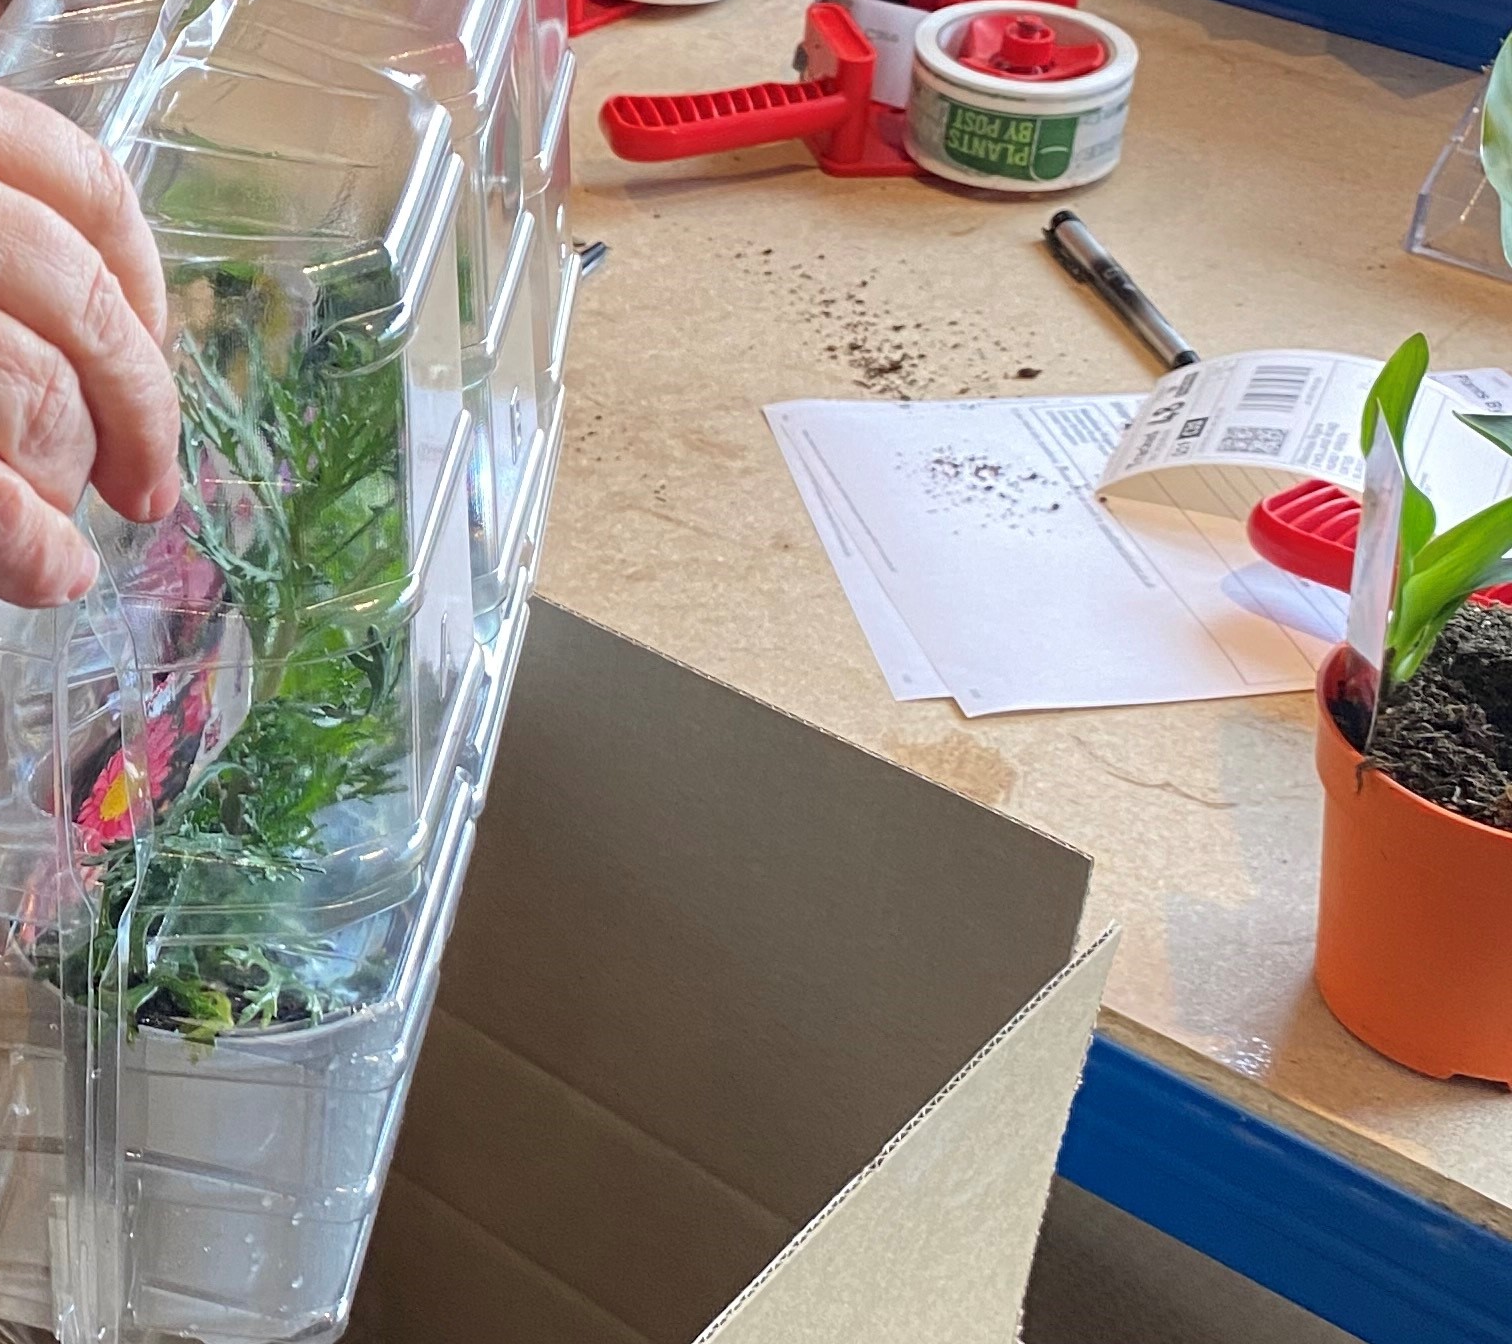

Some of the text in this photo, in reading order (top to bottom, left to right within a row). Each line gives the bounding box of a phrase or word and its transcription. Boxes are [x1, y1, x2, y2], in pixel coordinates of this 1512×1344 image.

[952, 108, 1033, 144] BY POST
[947, 129, 1030, 167] PLANTS
